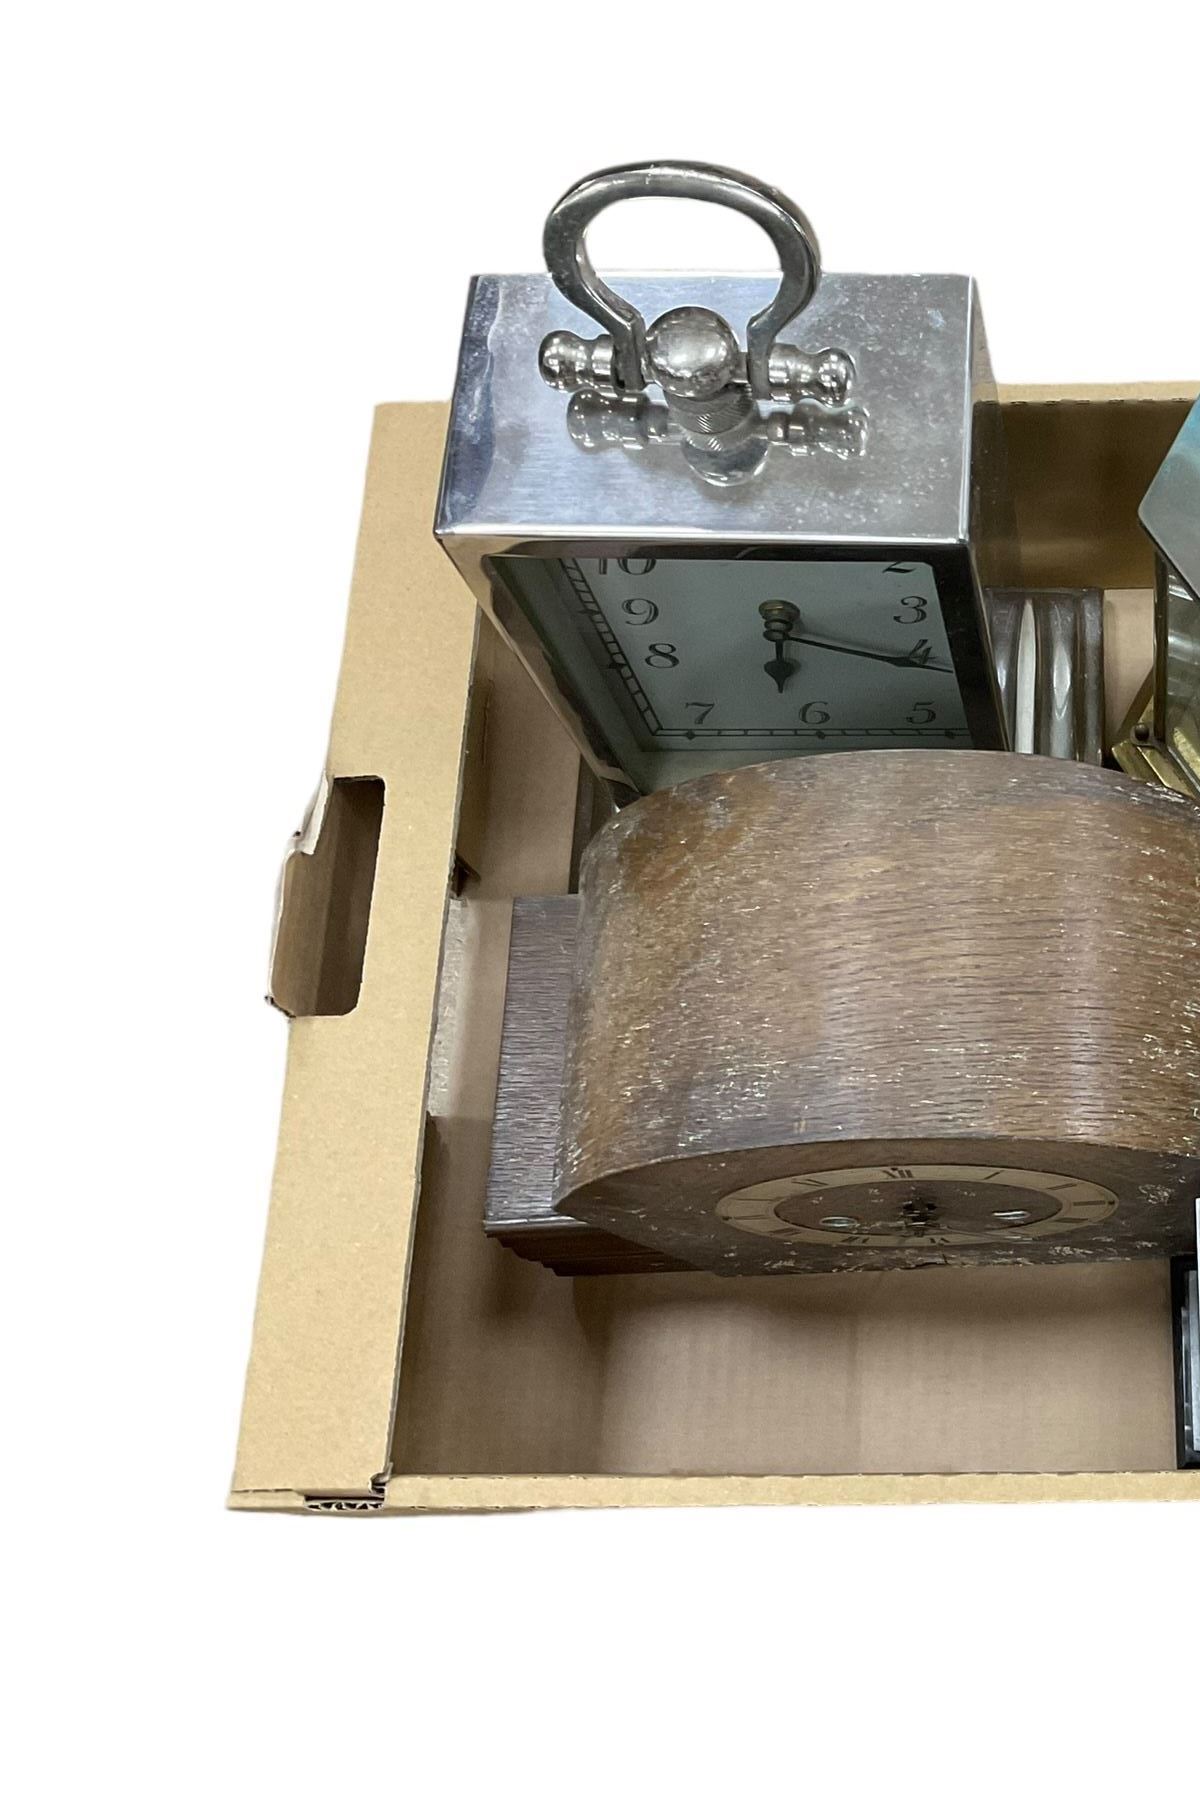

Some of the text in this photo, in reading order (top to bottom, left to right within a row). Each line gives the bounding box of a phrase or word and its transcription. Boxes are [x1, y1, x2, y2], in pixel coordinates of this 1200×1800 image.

[621, 598, 659, 626] 9
[893, 595, 928, 625] 3
[644, 643, 680, 669] 8
[908, 638, 938, 666] 4
[685, 701, 715, 726] 7
[799, 701, 831, 726] 6
[905, 701, 937, 726] 5
